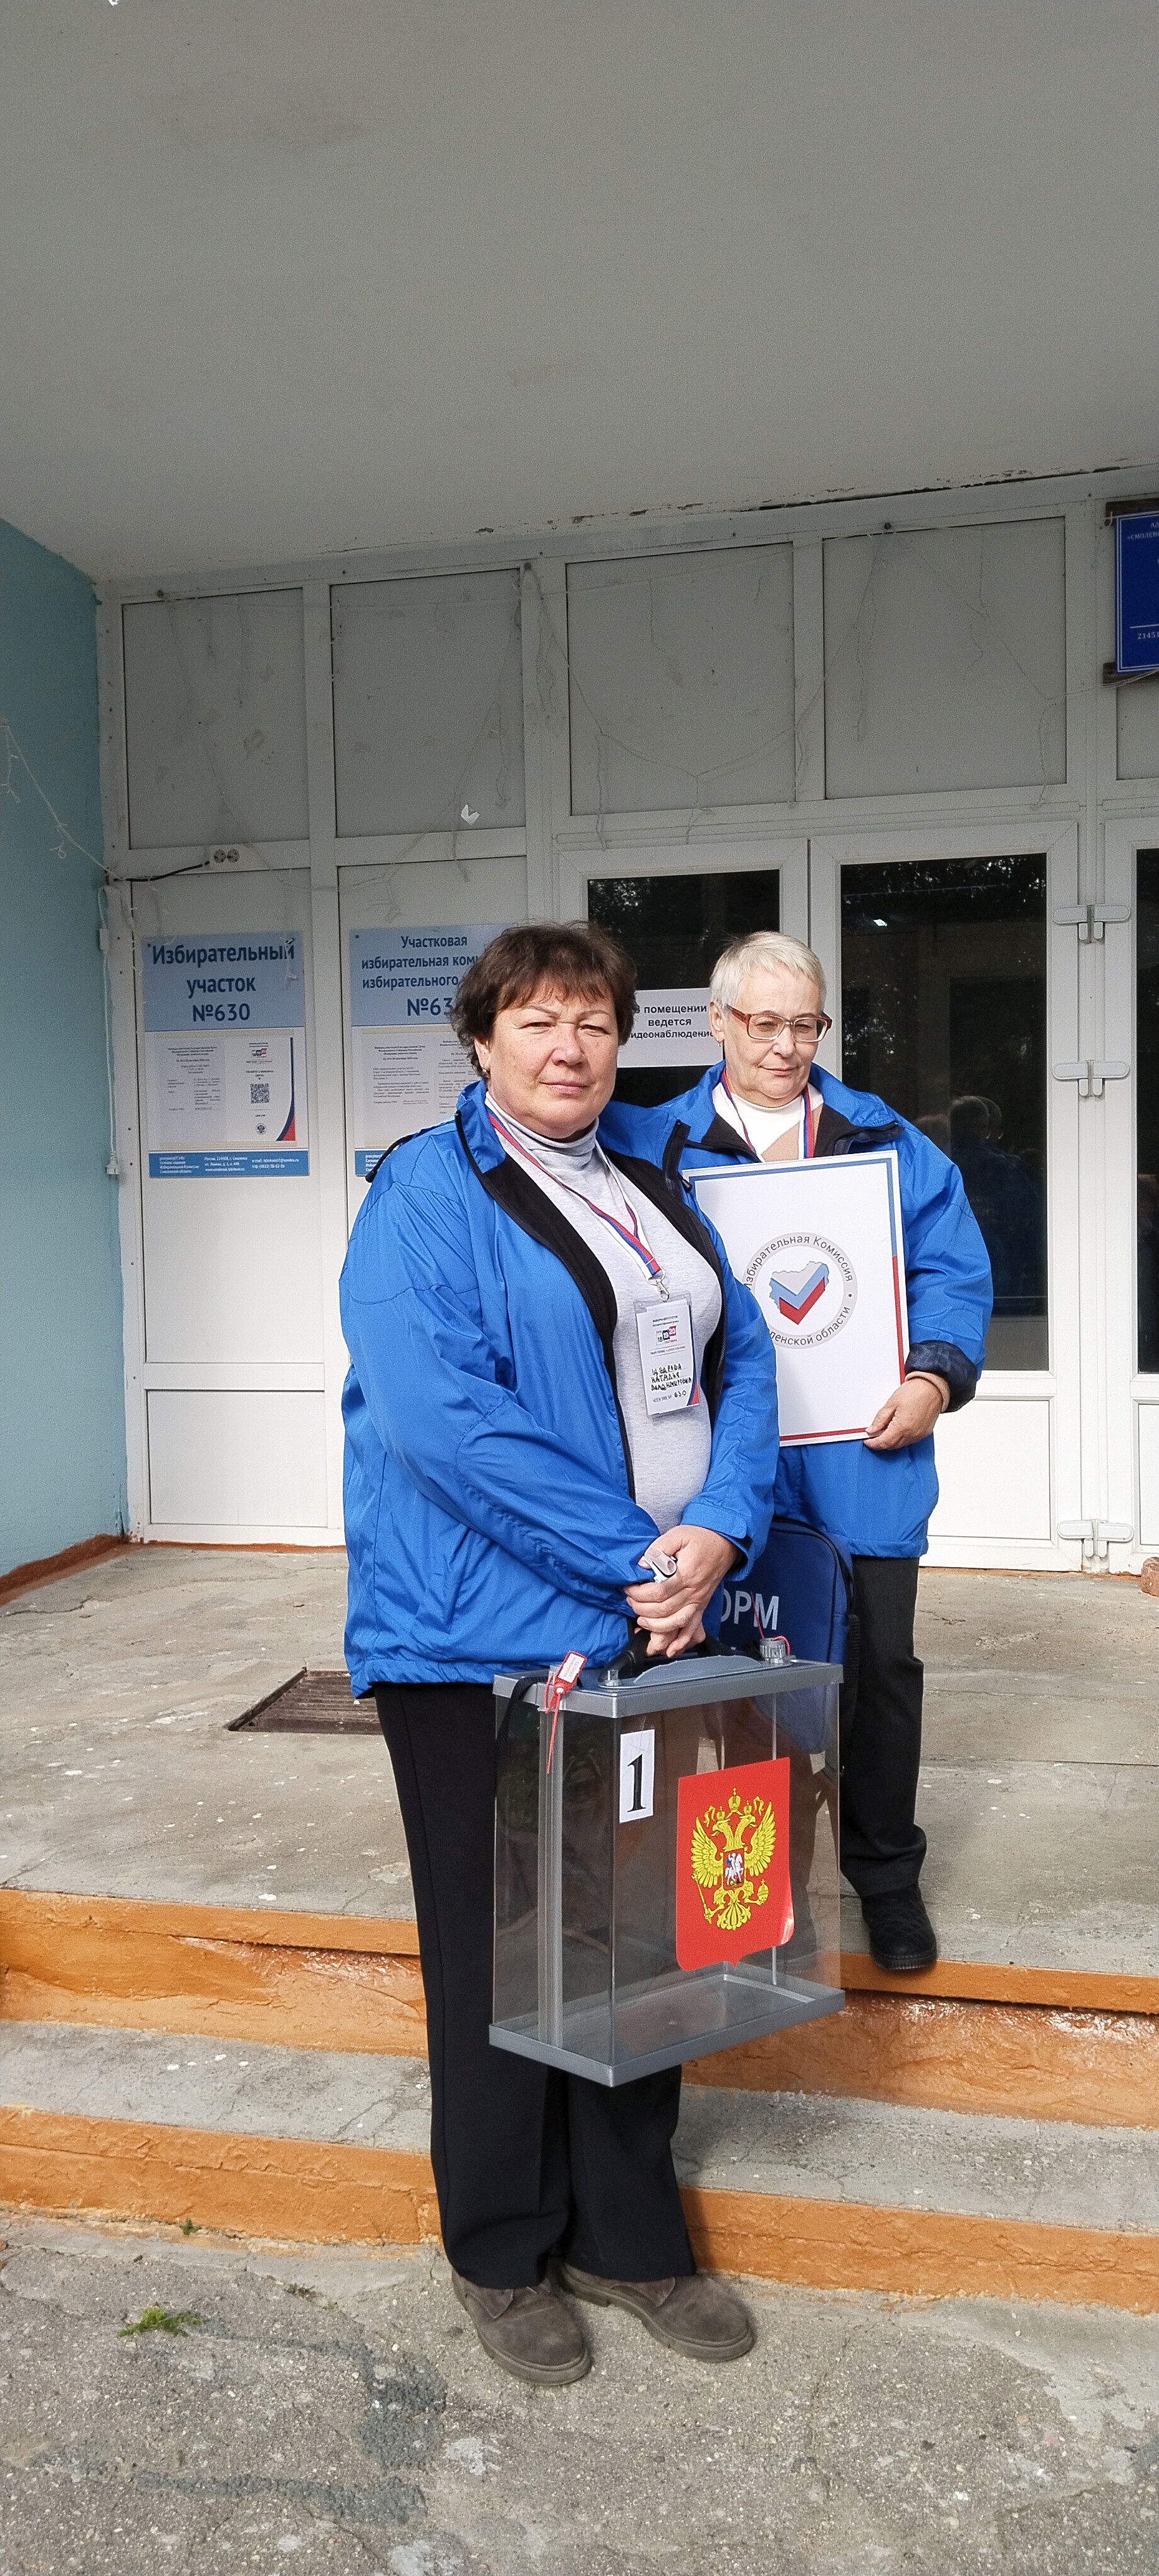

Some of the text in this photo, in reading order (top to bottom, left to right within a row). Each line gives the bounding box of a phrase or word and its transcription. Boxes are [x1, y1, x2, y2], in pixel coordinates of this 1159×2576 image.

[400, 936, 468, 948] Участковая
[153, 940, 295, 968] Избирательный
[362, 956, 478, 972] избирательная ком
[186, 977, 256, 999] участок
[362, 975, 458, 991] избирательного
[192, 1003, 251, 1022] №630
[407, 997, 454, 1017] №63
[644, 1005, 707, 1015] помещении
[648, 1018, 692, 1028] ведется
[631, 1030, 714, 1040] идеонаблюдение
[812, 1236, 853, 1282] Комиссия
[770, 1306, 850, 1346] ленской области
[627, 1753, 647, 1813] 1
